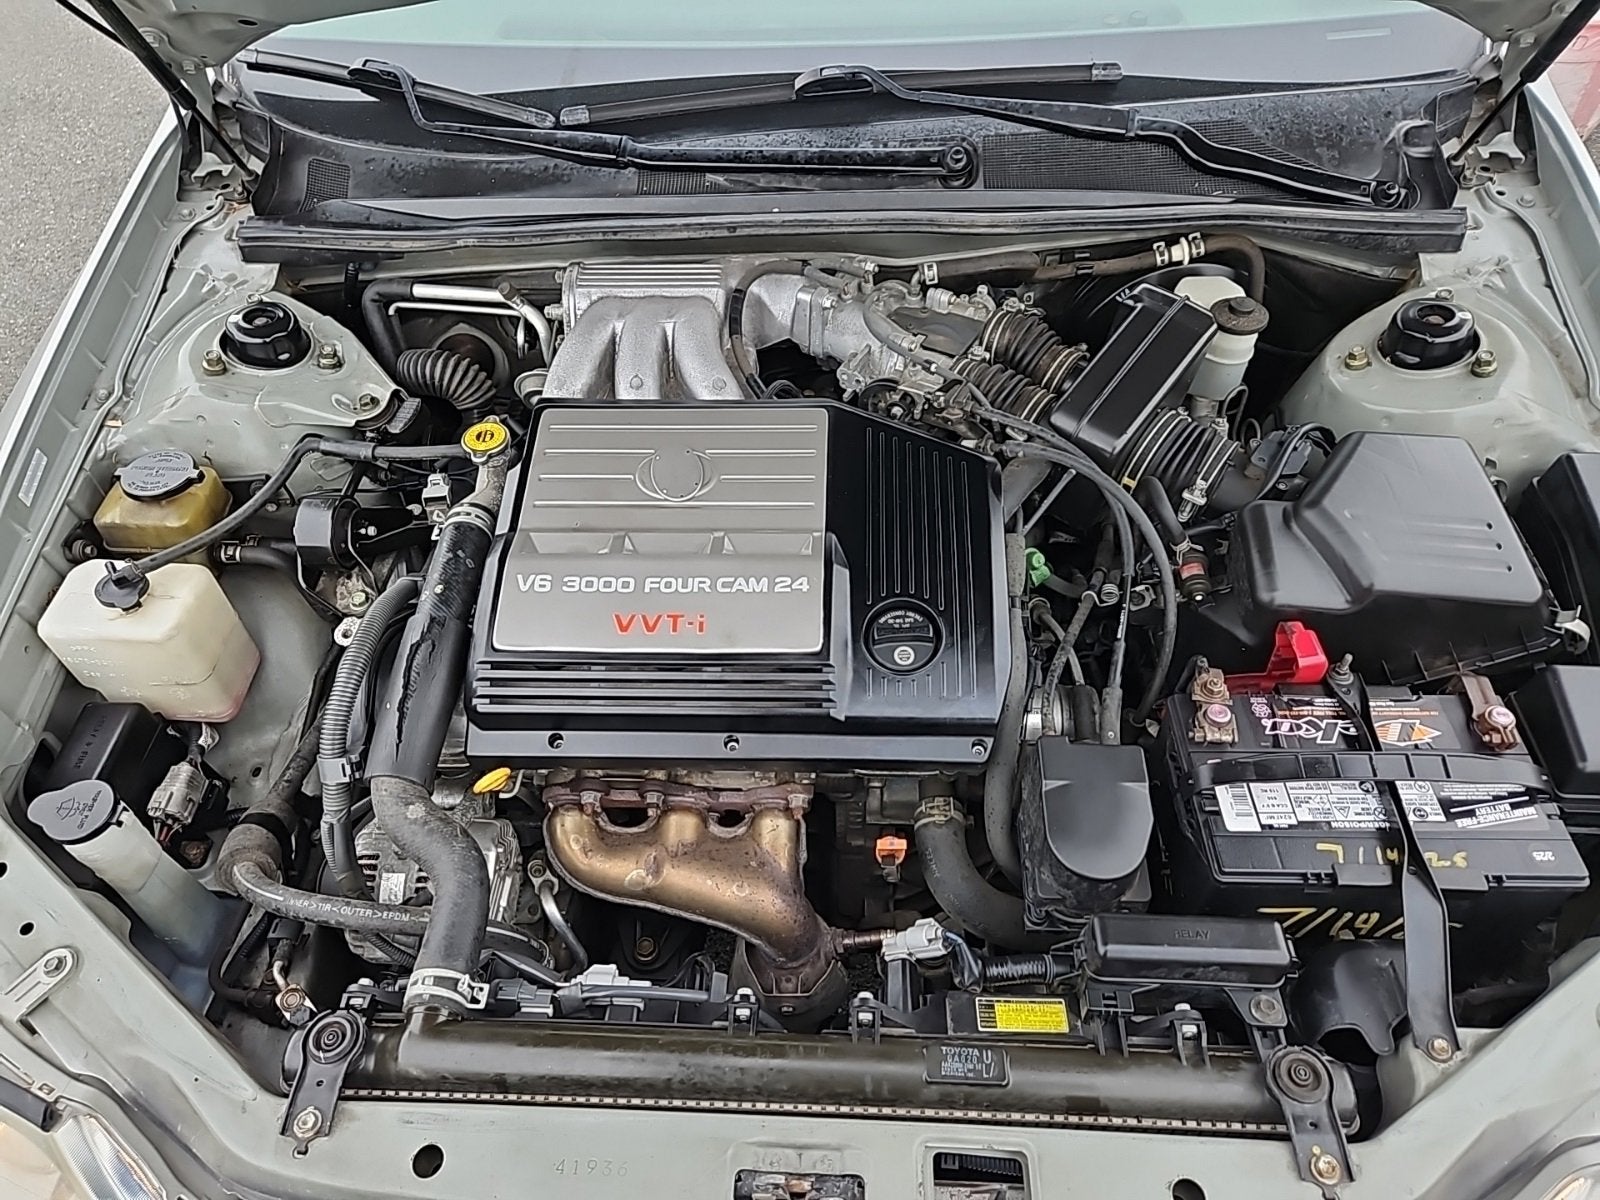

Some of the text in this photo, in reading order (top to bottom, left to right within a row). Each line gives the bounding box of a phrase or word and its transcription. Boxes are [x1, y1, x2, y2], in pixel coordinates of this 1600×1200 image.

[516, 574, 810, 594] V6 3000 FOUR CAM 24
[612, 612, 706, 635] VVT-i
[1454, 805, 1537, 827] MAINTENANCE-FREE
[1474, 802, 1511, 816] BATTERY
[1174, 928, 1211, 940] RELAY
[940, 1046, 980, 1057] TOYOTA
[982, 1049, 992, 1064] U
[553, 1158, 628, 1177] 41936
